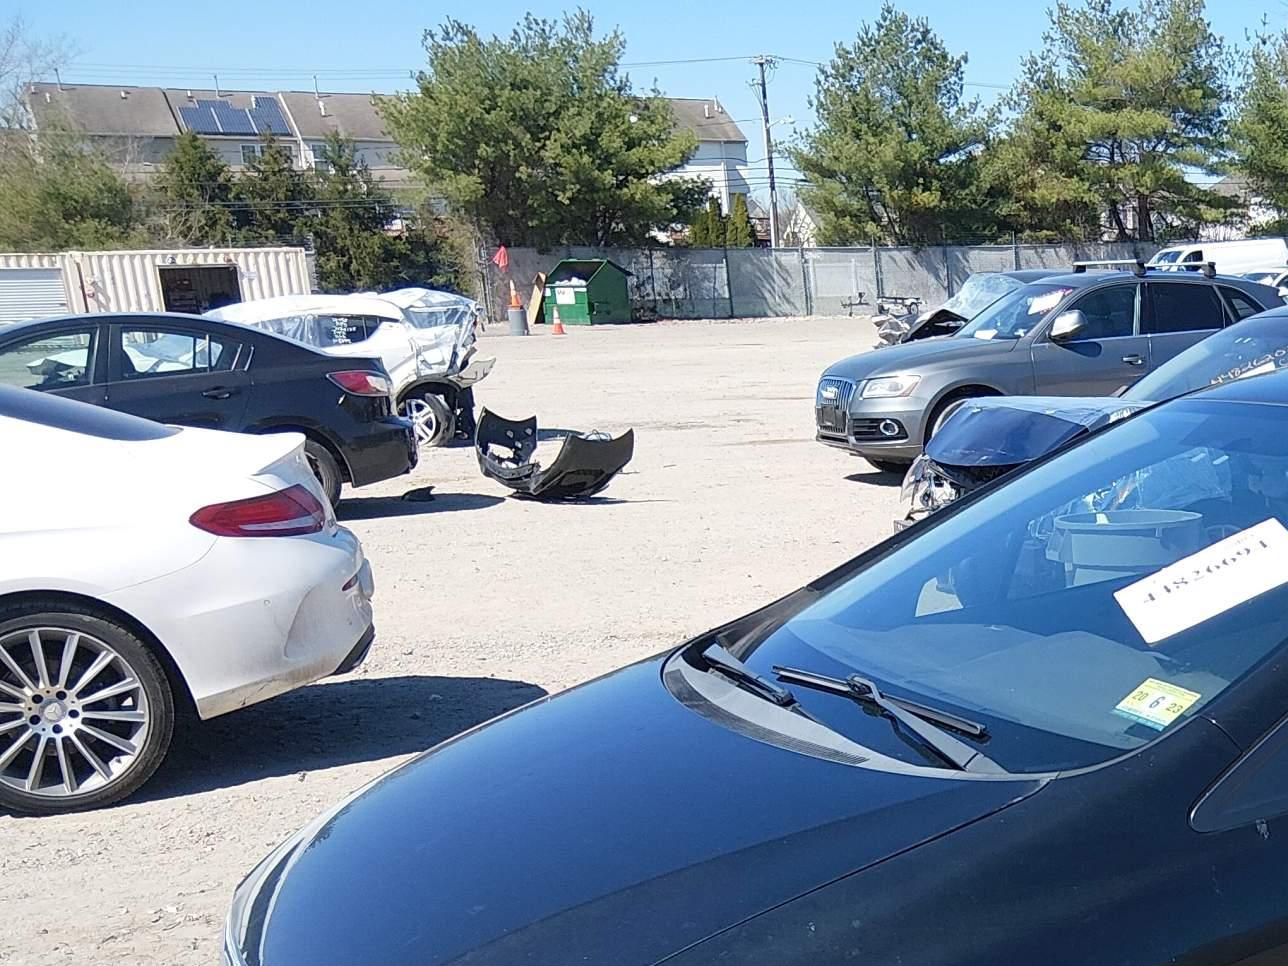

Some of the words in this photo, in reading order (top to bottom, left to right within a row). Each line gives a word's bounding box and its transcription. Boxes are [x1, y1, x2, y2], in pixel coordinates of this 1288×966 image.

[1131, 690, 1149, 702] 20
[1148, 696, 1166, 709] 6
[1165, 702, 1184, 714] 23
